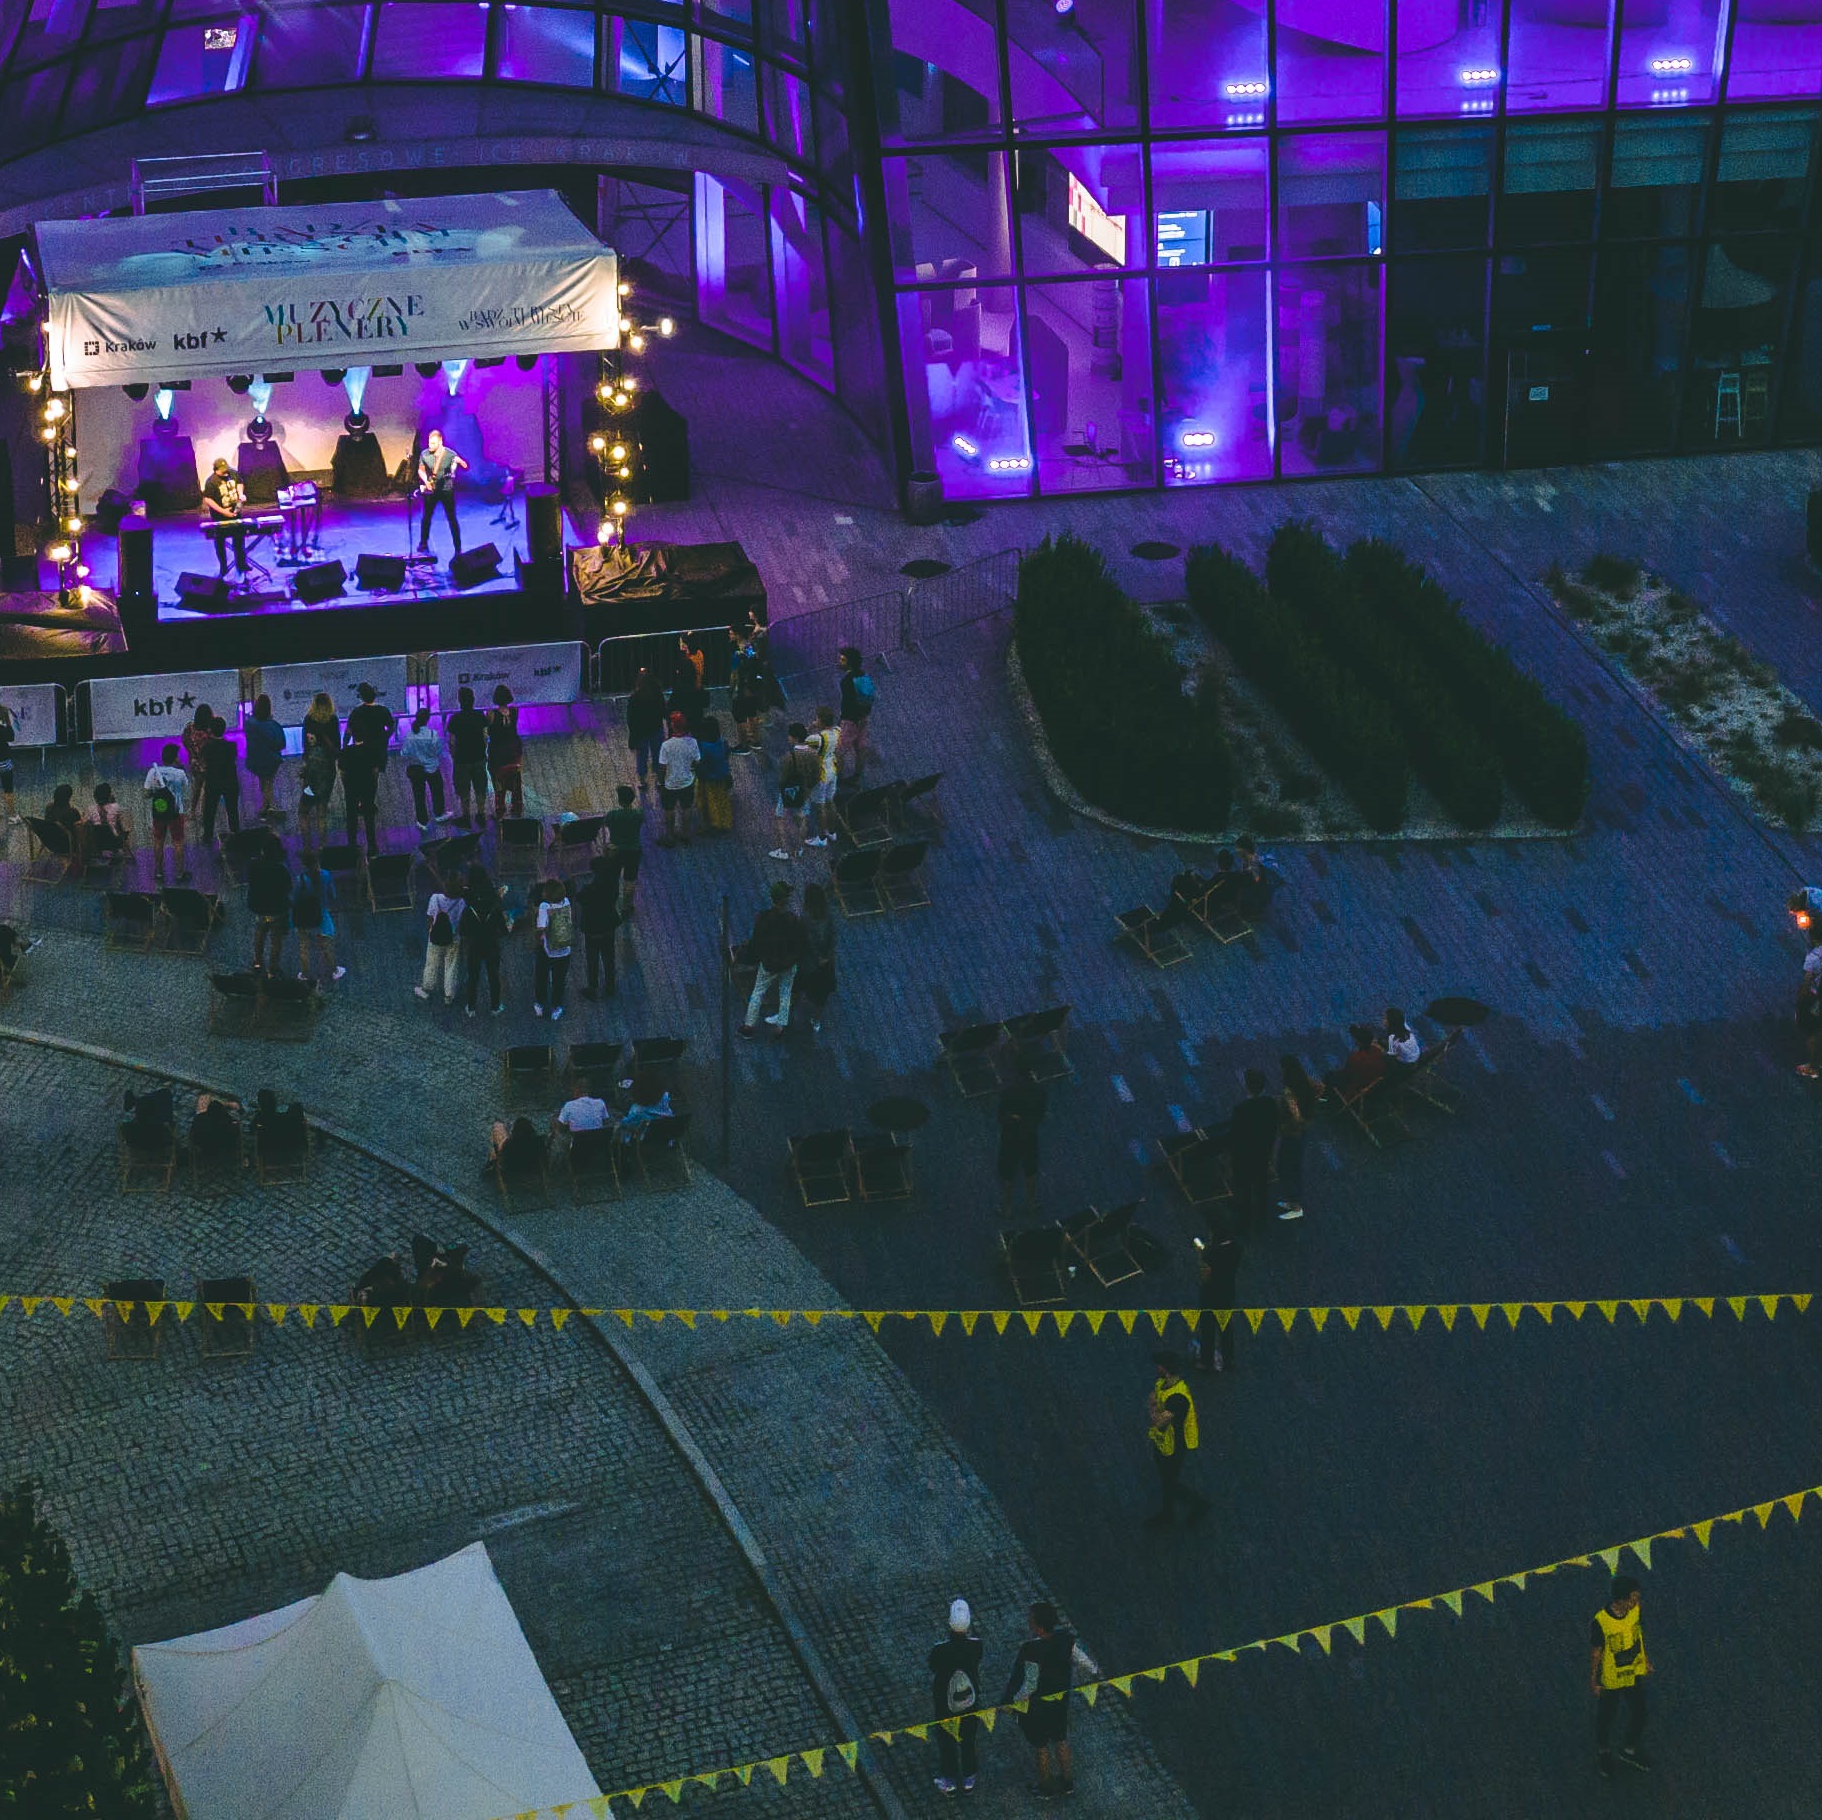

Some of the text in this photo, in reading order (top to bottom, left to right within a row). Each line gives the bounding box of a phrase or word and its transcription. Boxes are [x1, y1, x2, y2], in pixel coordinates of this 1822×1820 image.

[263, 294, 425, 326] MUZYCZNE
[276, 315, 409, 345] PLENERY
[105, 338, 157, 353] Kraków
[173, 331, 208, 351] kbf
[133, 697, 175, 717] kbf
